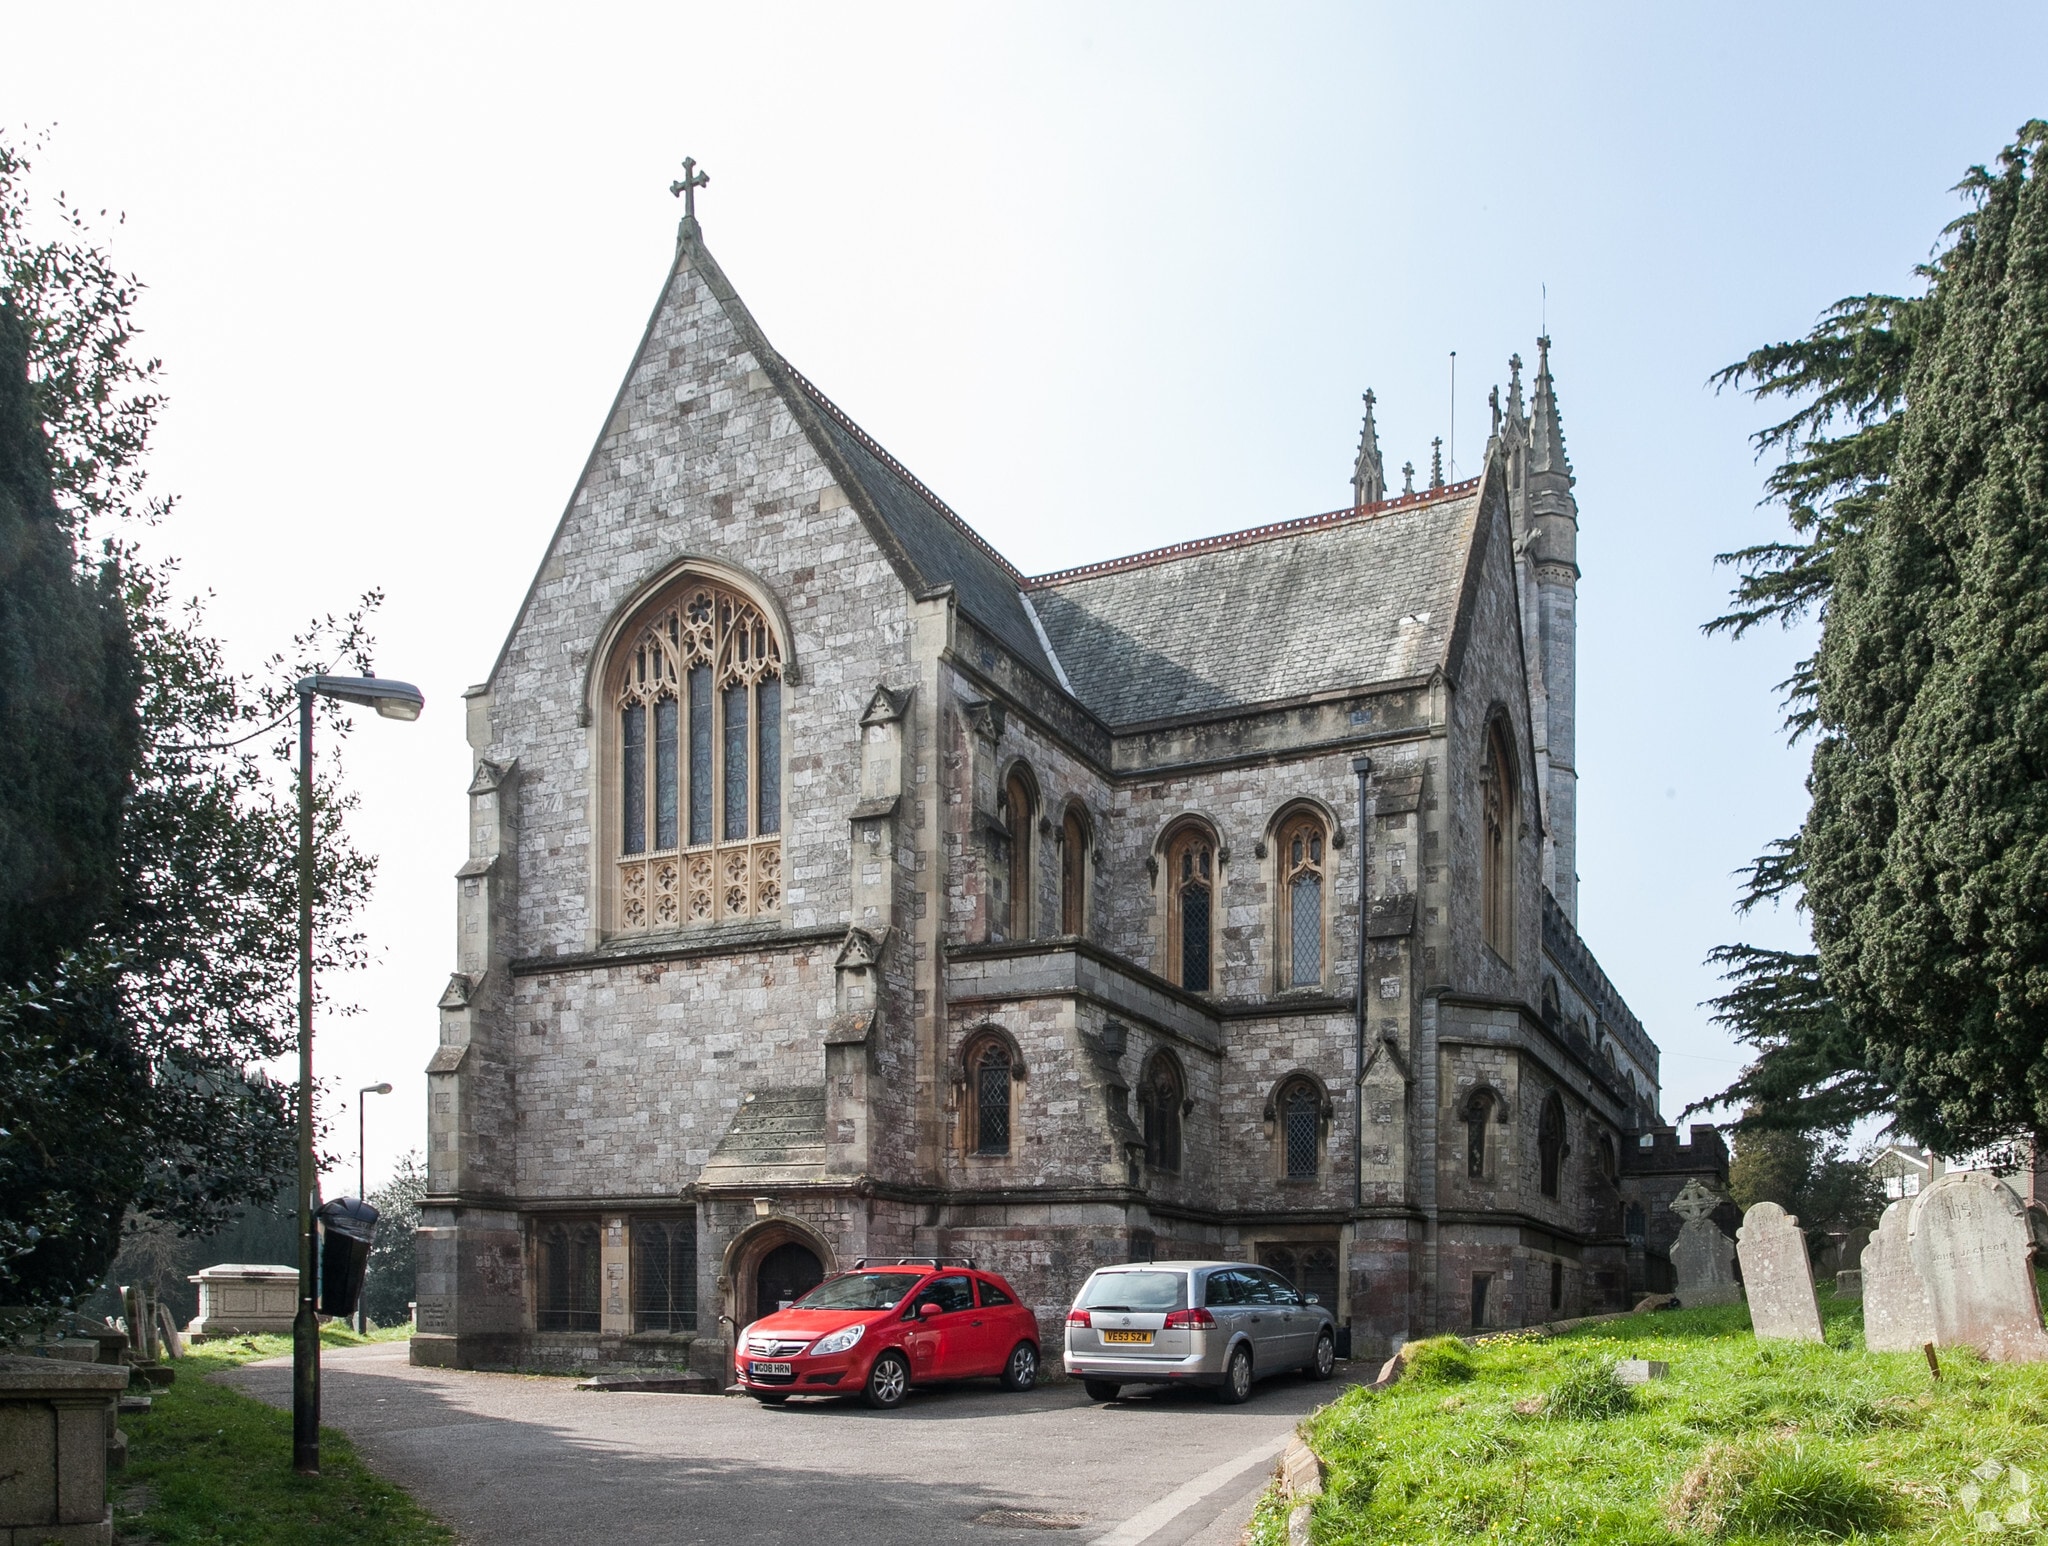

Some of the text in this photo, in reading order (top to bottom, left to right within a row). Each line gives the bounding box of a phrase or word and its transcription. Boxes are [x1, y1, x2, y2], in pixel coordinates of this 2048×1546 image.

[1107, 1331, 1148, 1342] VE53 SZW
[754, 1363, 790, 1373] WG08 HRN
